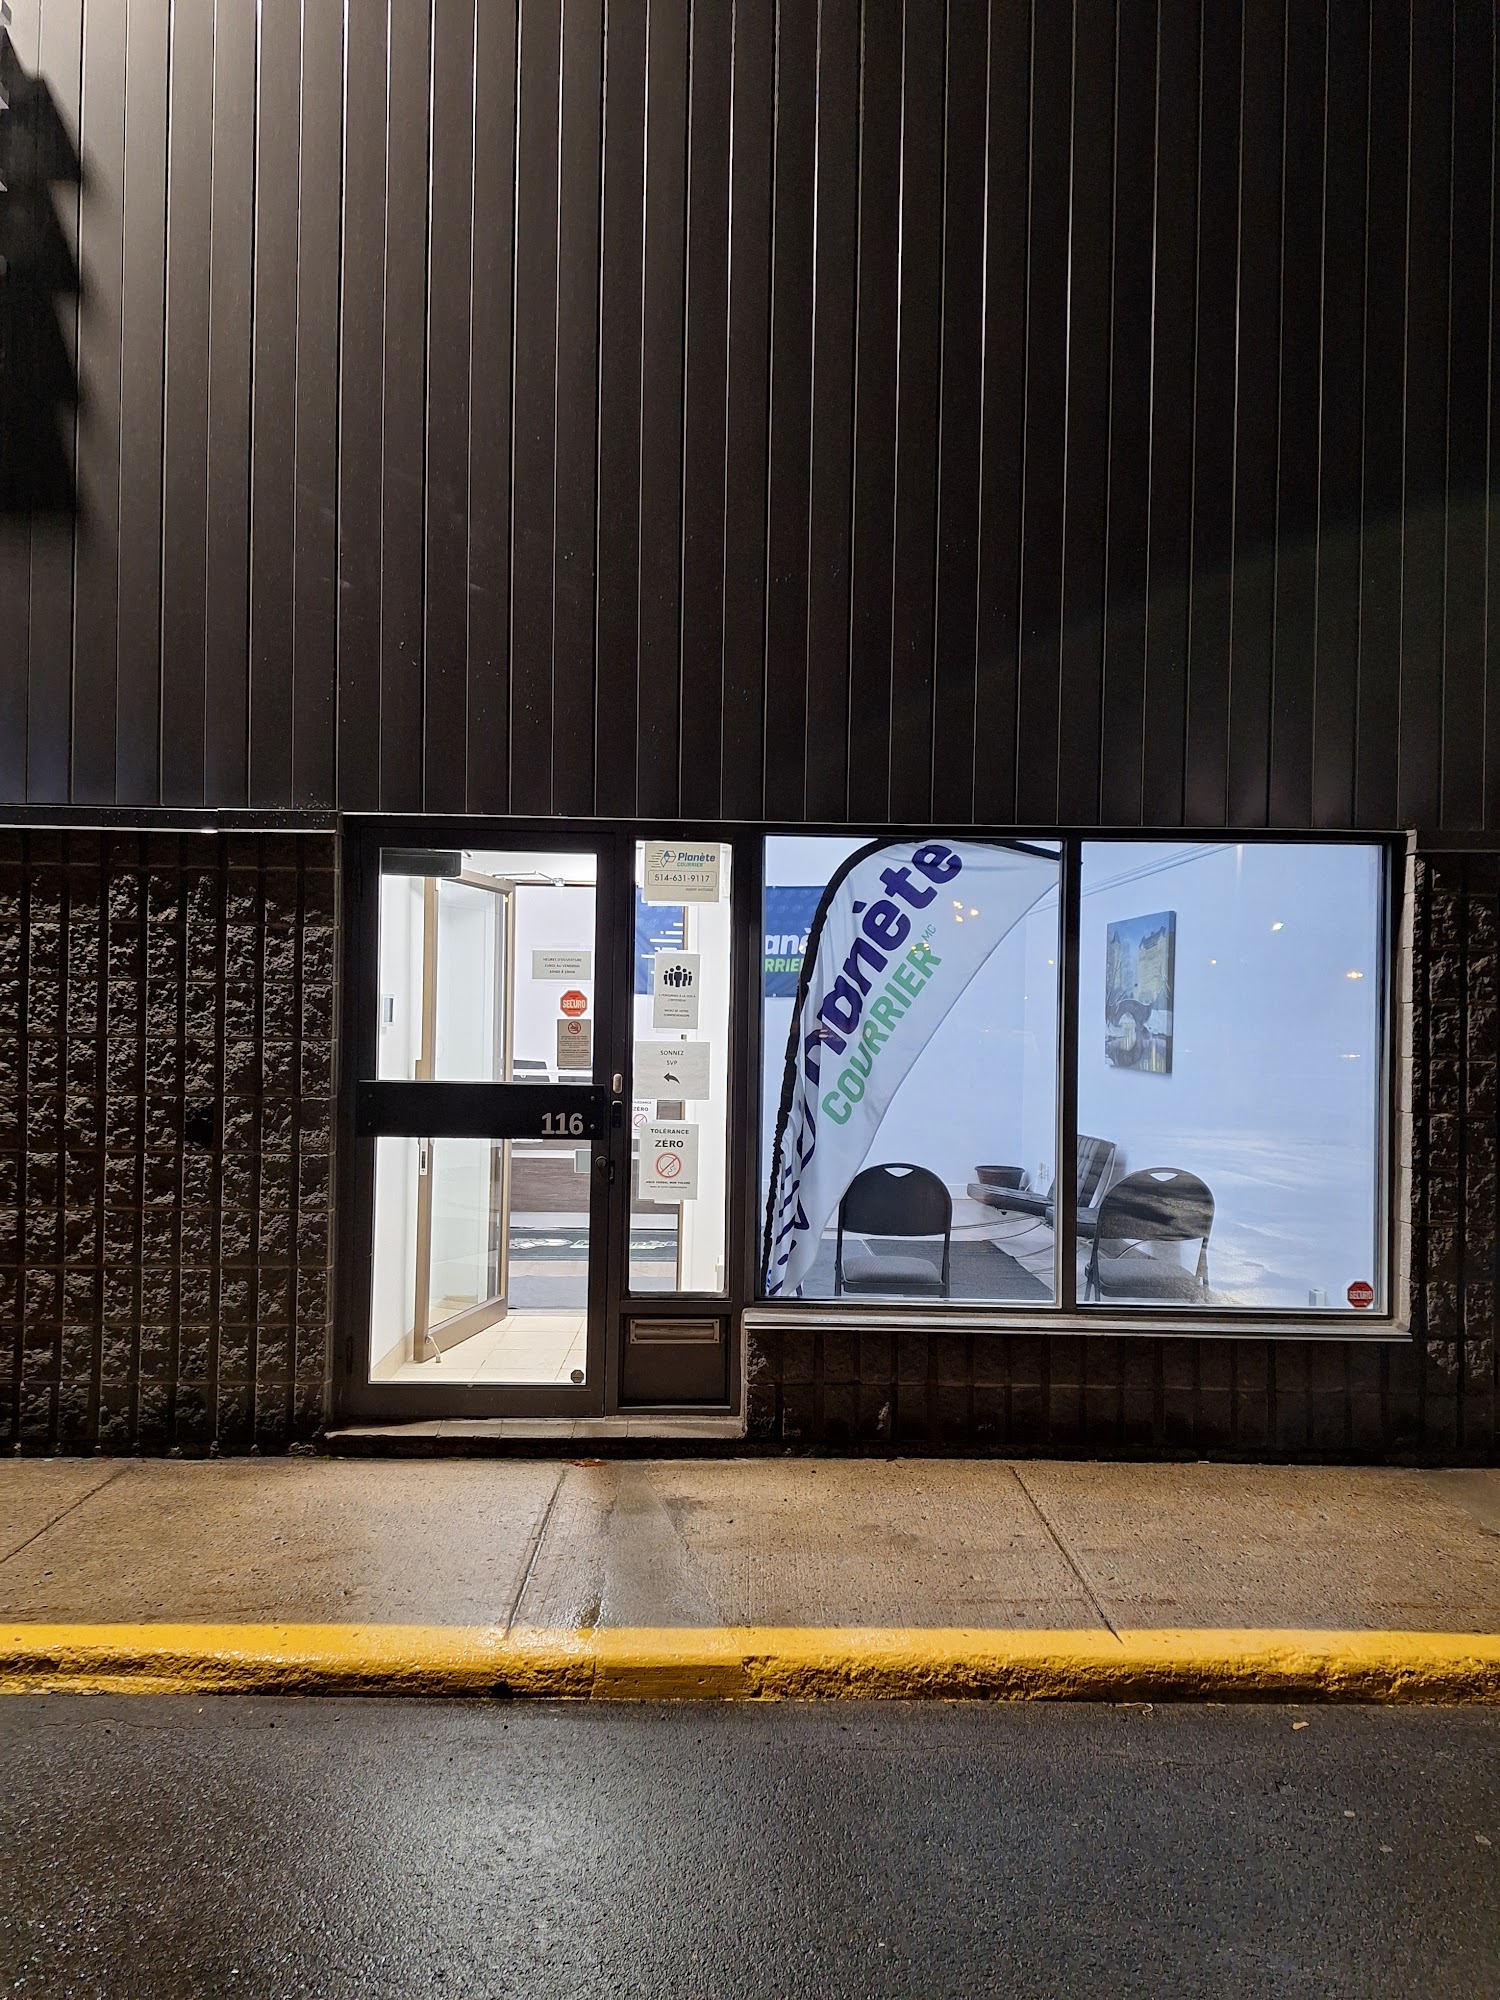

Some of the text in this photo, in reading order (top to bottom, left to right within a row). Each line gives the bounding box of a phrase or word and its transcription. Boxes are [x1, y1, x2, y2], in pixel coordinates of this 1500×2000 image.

[677, 852, 716, 862] Planète
[654, 874, 710, 882] 514-631-9117
[821, 942, 942, 1125] COURRIER
[541, 1112, 584, 1135] 116
[654, 1138, 684, 1148] ZÉRO
